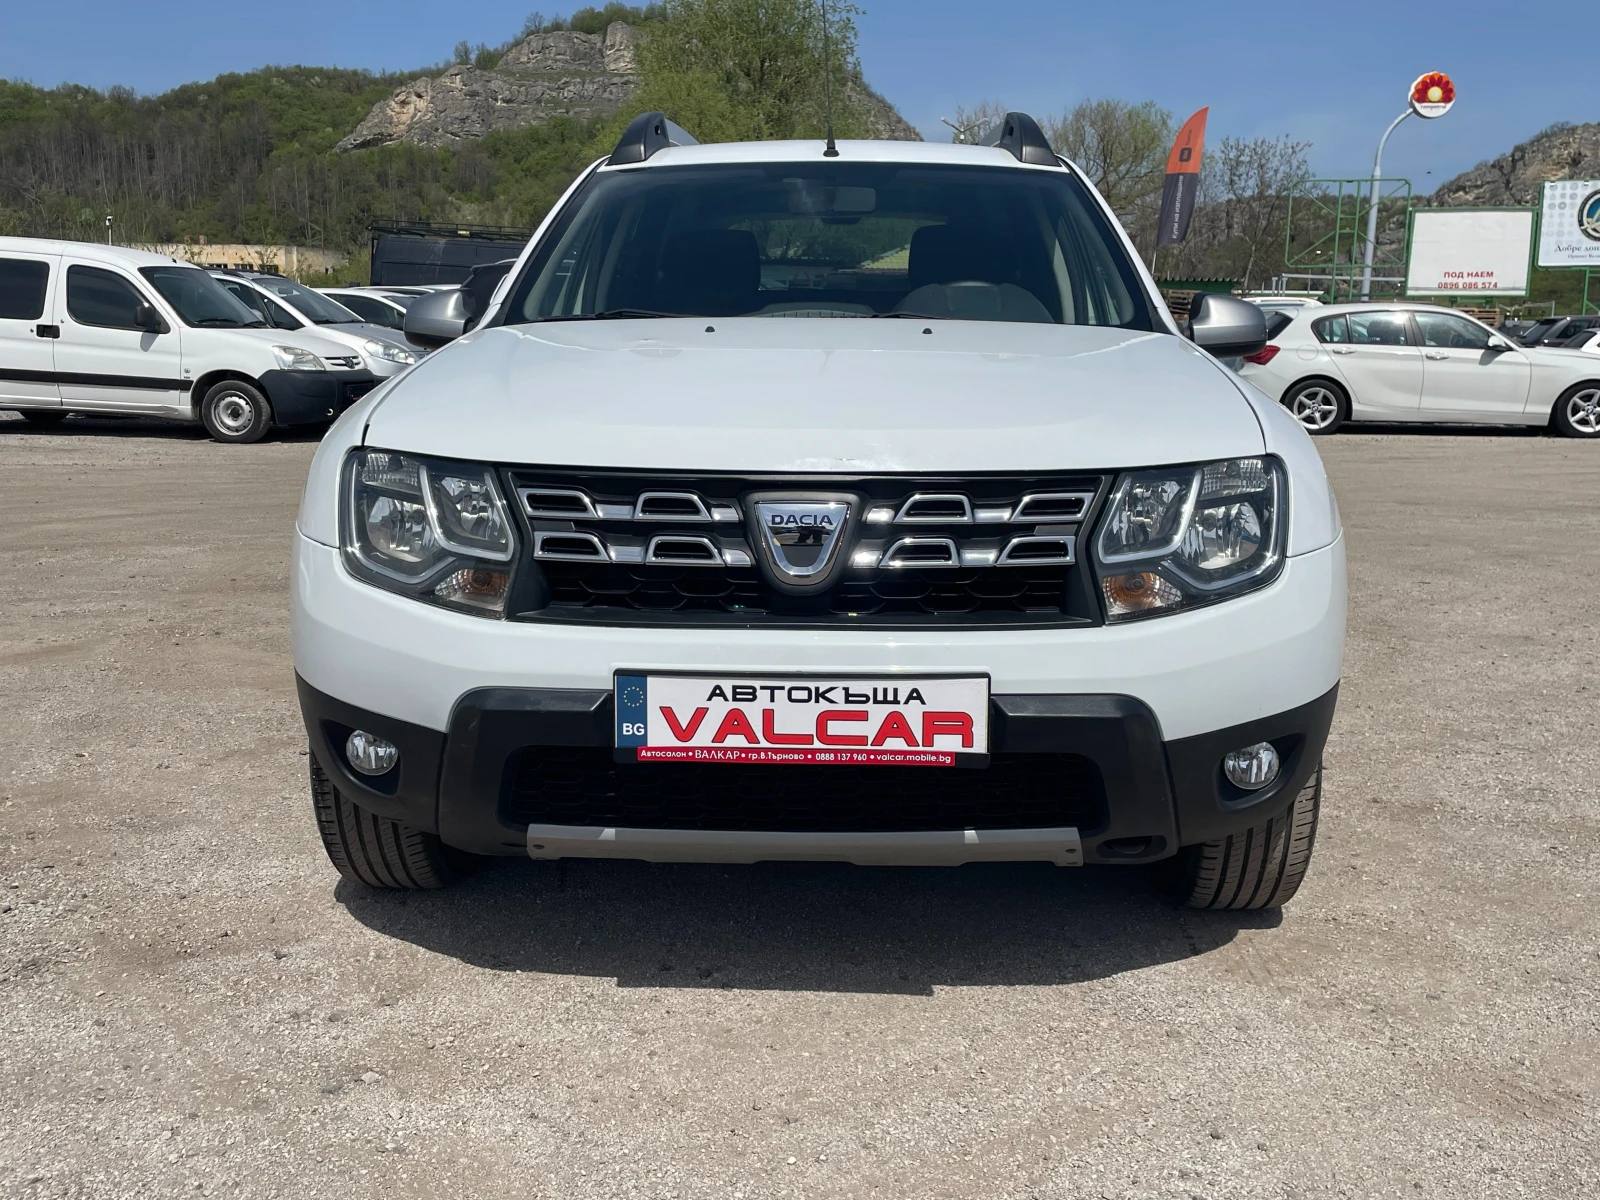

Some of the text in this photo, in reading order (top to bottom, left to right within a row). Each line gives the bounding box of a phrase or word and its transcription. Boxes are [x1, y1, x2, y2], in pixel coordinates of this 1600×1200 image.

[1443, 271, 1464, 279] ПОД
[771, 514, 834, 526] DACIA
[706, 684, 927, 706] АВТОКЪЩА
[622, 722, 645, 736] BG
[659, 706, 974, 748] VALCAR
[640, 750, 687, 758] Автосалон
[694, 749, 740, 760] ВАЛКАР
[815, 753, 835, 761] 0888
[837, 753, 850, 761] 137
[853, 753, 867, 761] 960
[876, 753, 951, 763] valcar.mobile.bg
